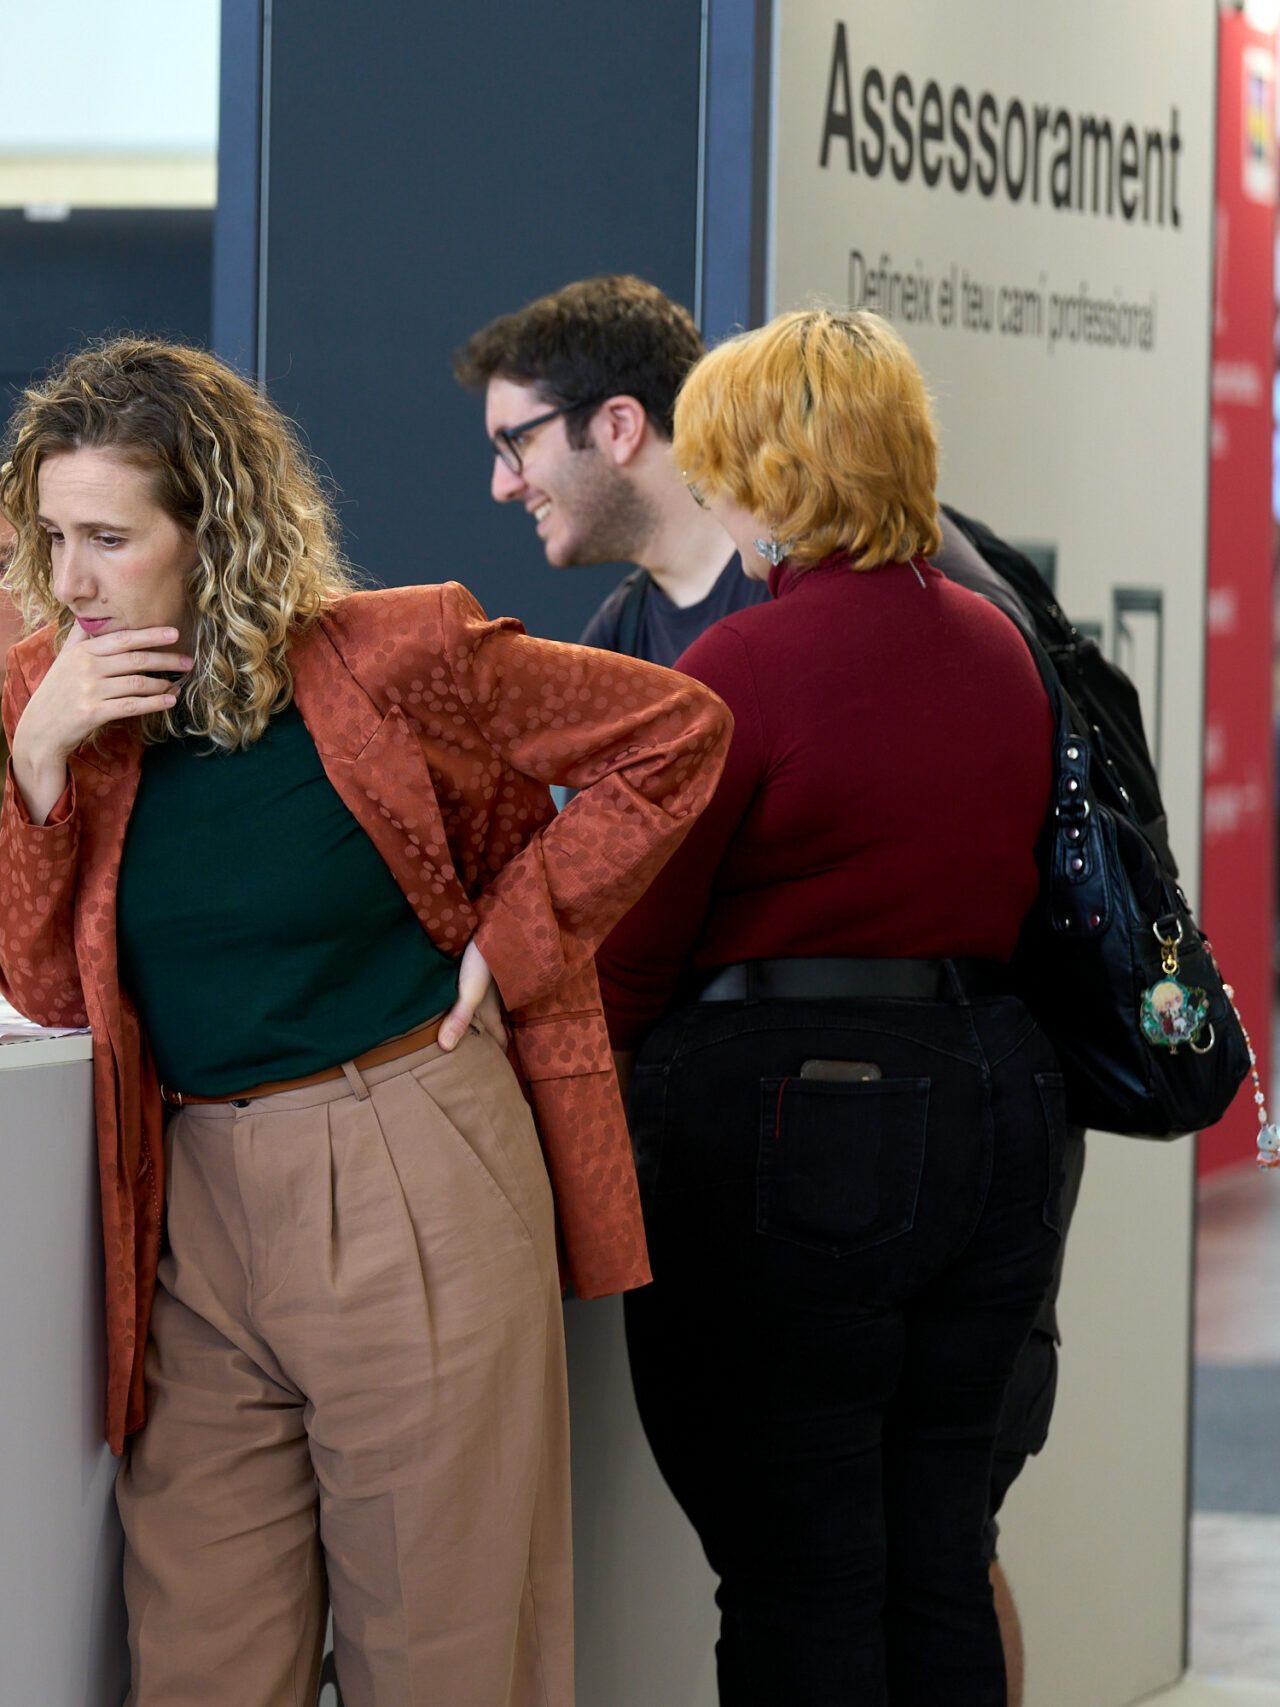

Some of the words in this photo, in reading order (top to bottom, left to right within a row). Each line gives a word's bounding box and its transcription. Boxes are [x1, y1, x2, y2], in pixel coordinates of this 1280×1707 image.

[818, 21, 1183, 231] Assessorament
[848, 248, 935, 323] Defineix
[936, 262, 959, 330] el
[960, 267, 993, 334] teu
[1048, 279, 1158, 355] professional
